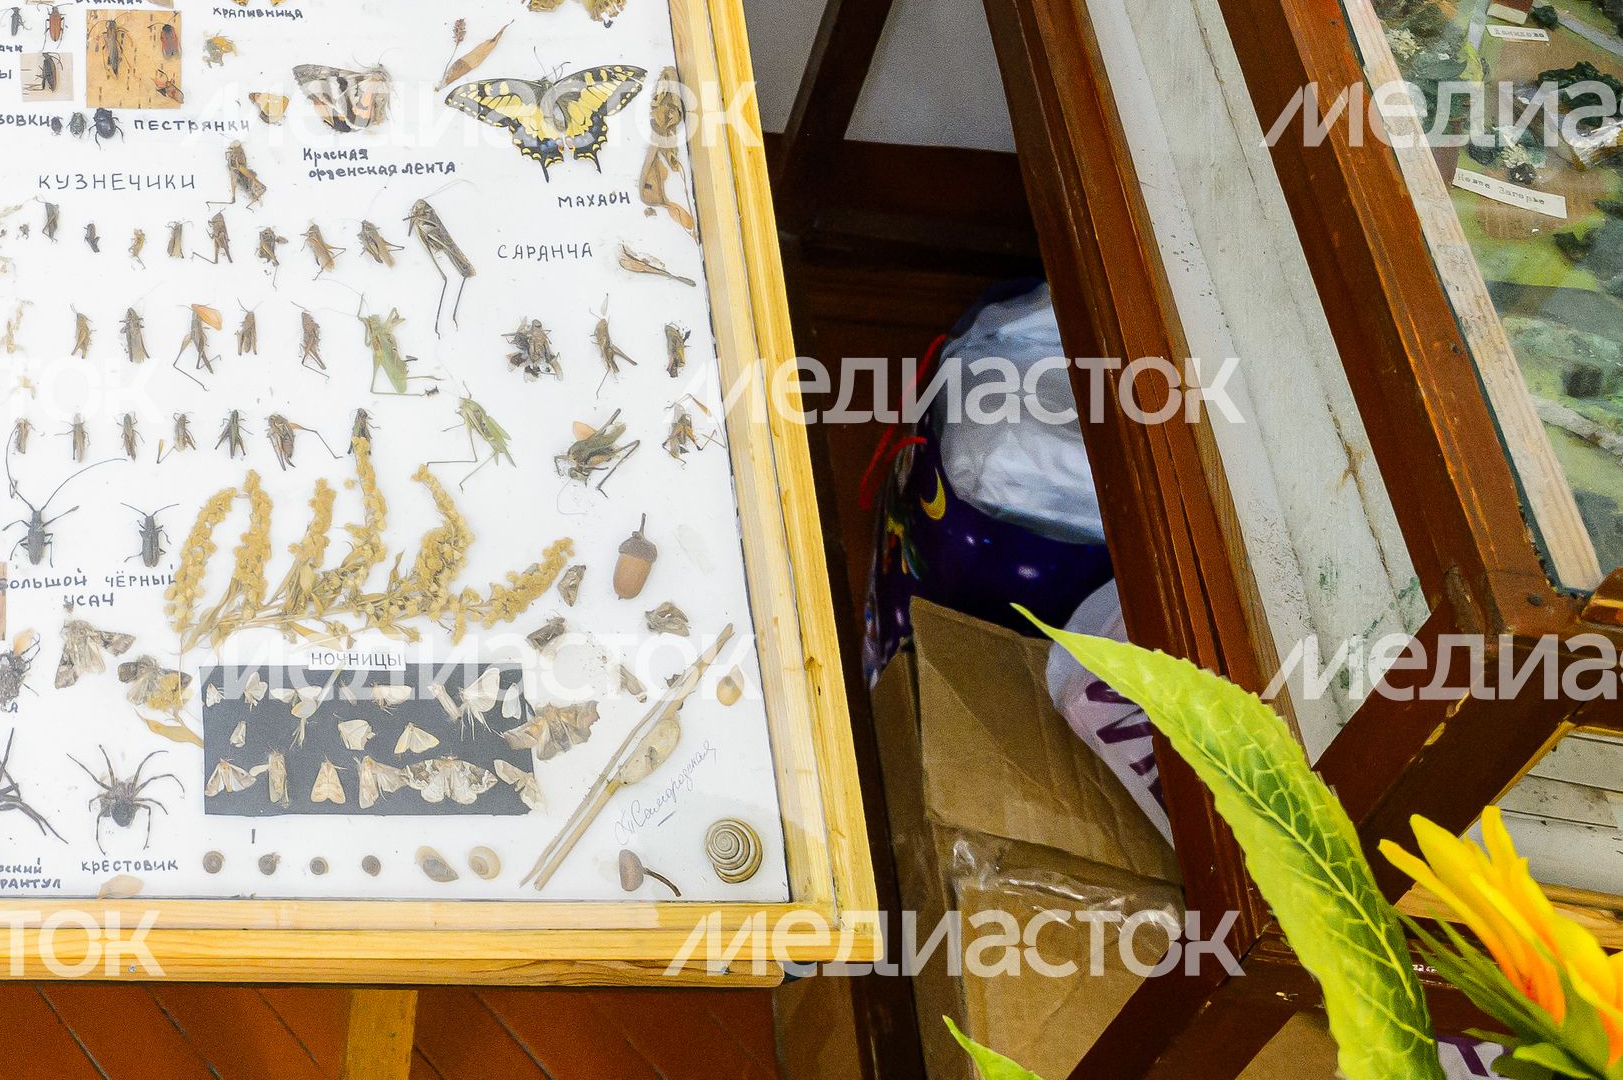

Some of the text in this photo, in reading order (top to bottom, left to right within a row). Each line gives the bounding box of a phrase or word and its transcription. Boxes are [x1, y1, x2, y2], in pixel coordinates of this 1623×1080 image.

[134, 119, 250, 133] ПЕСТРЯНКИ
[38, 172, 196, 191] КУЗНЕЧИКИ
[558, 190, 632, 209] МАХАОН
[497, 241, 594, 262] САРАНЧА
[310, 650, 405, 669] НОЧНИЦЫ
[80, 859, 179, 873] КРЕСТОВИК
